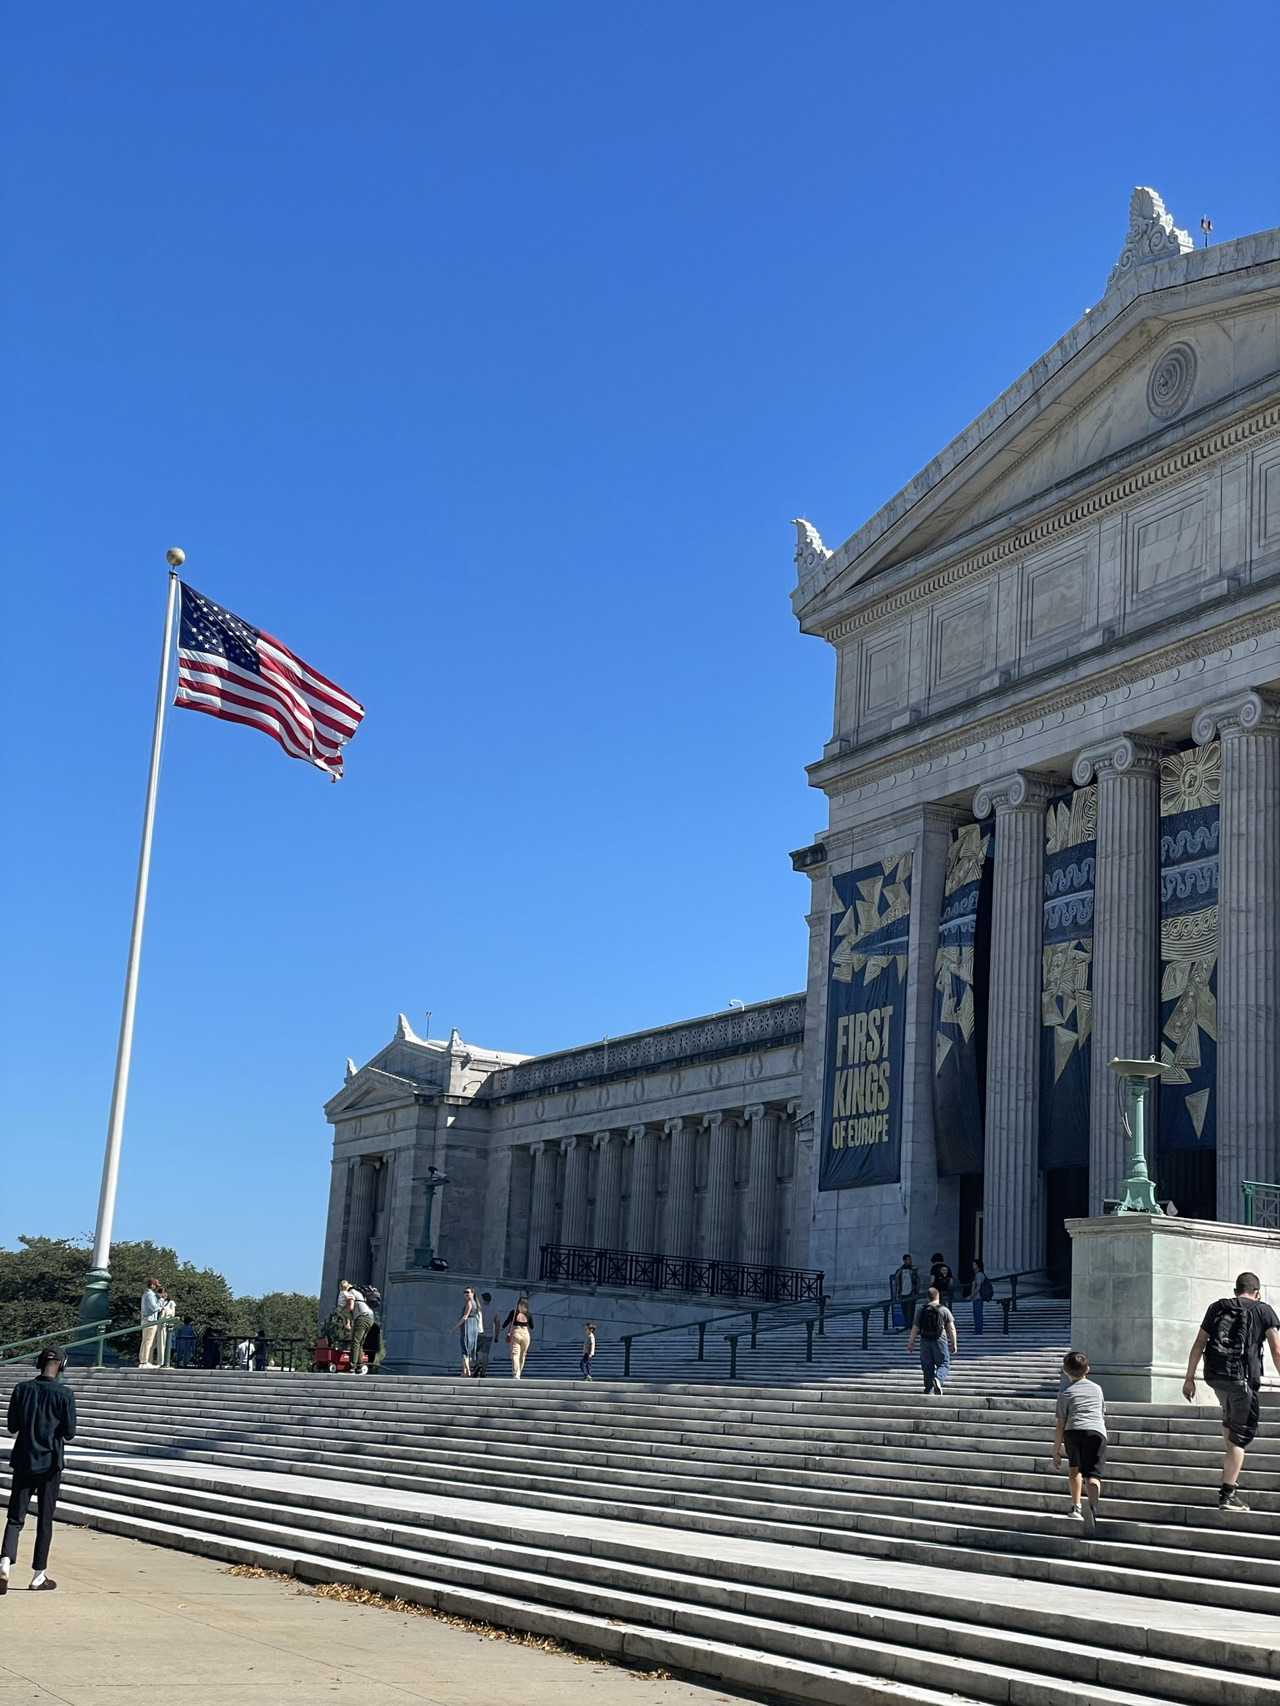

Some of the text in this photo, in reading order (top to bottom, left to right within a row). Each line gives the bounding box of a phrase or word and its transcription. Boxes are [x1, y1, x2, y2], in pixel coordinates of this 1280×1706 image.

[836, 1005, 893, 1068] FIRST
[832, 1061, 891, 1118] KINGS
[832, 1113, 889, 1150] OF EUROPE
